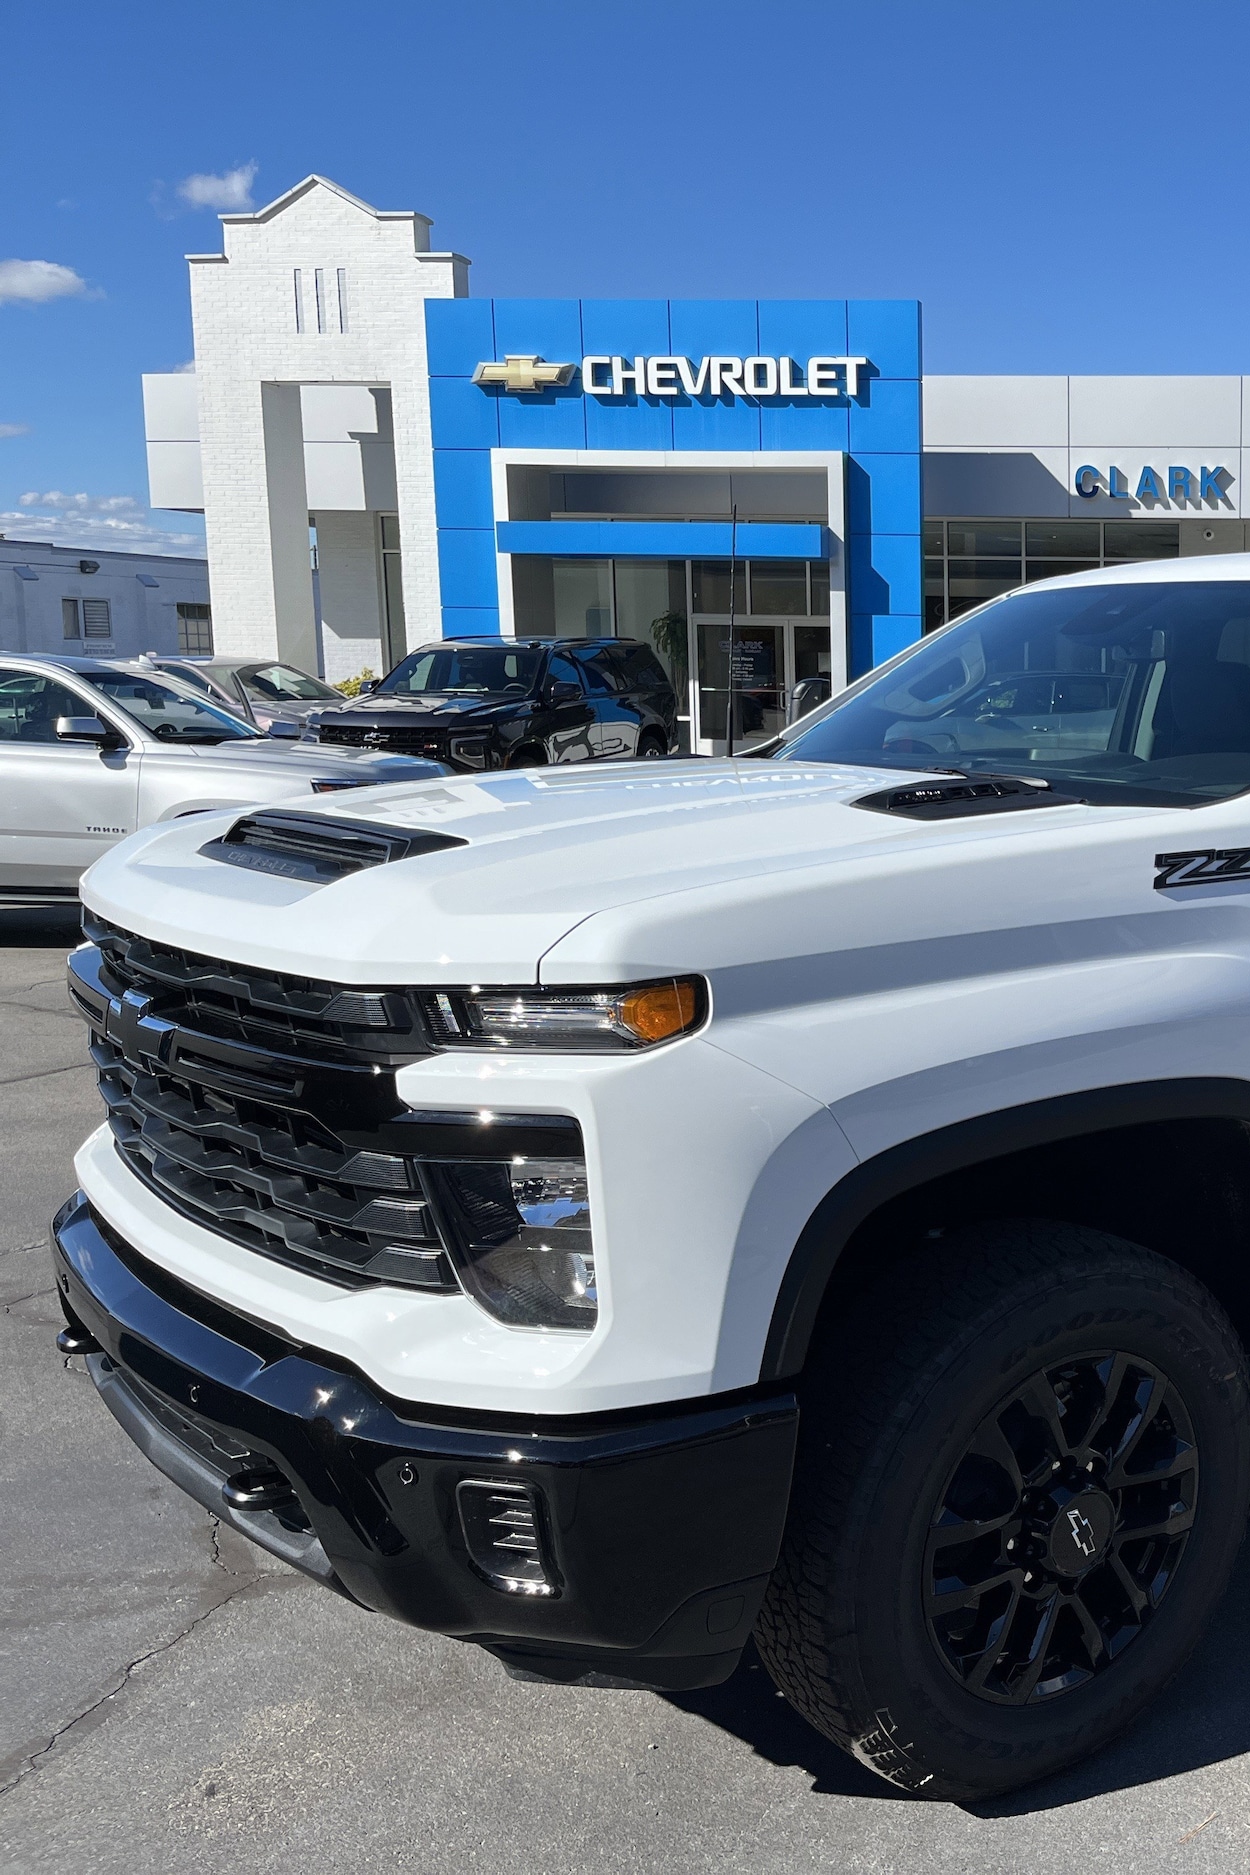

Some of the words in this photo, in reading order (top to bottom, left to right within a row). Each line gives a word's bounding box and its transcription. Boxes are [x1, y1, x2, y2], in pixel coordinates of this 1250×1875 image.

[582, 356, 867, 395] CHEVROLET
[1075, 465, 1225, 499] CLARK
[86, 826, 128, 834] TAHOE
